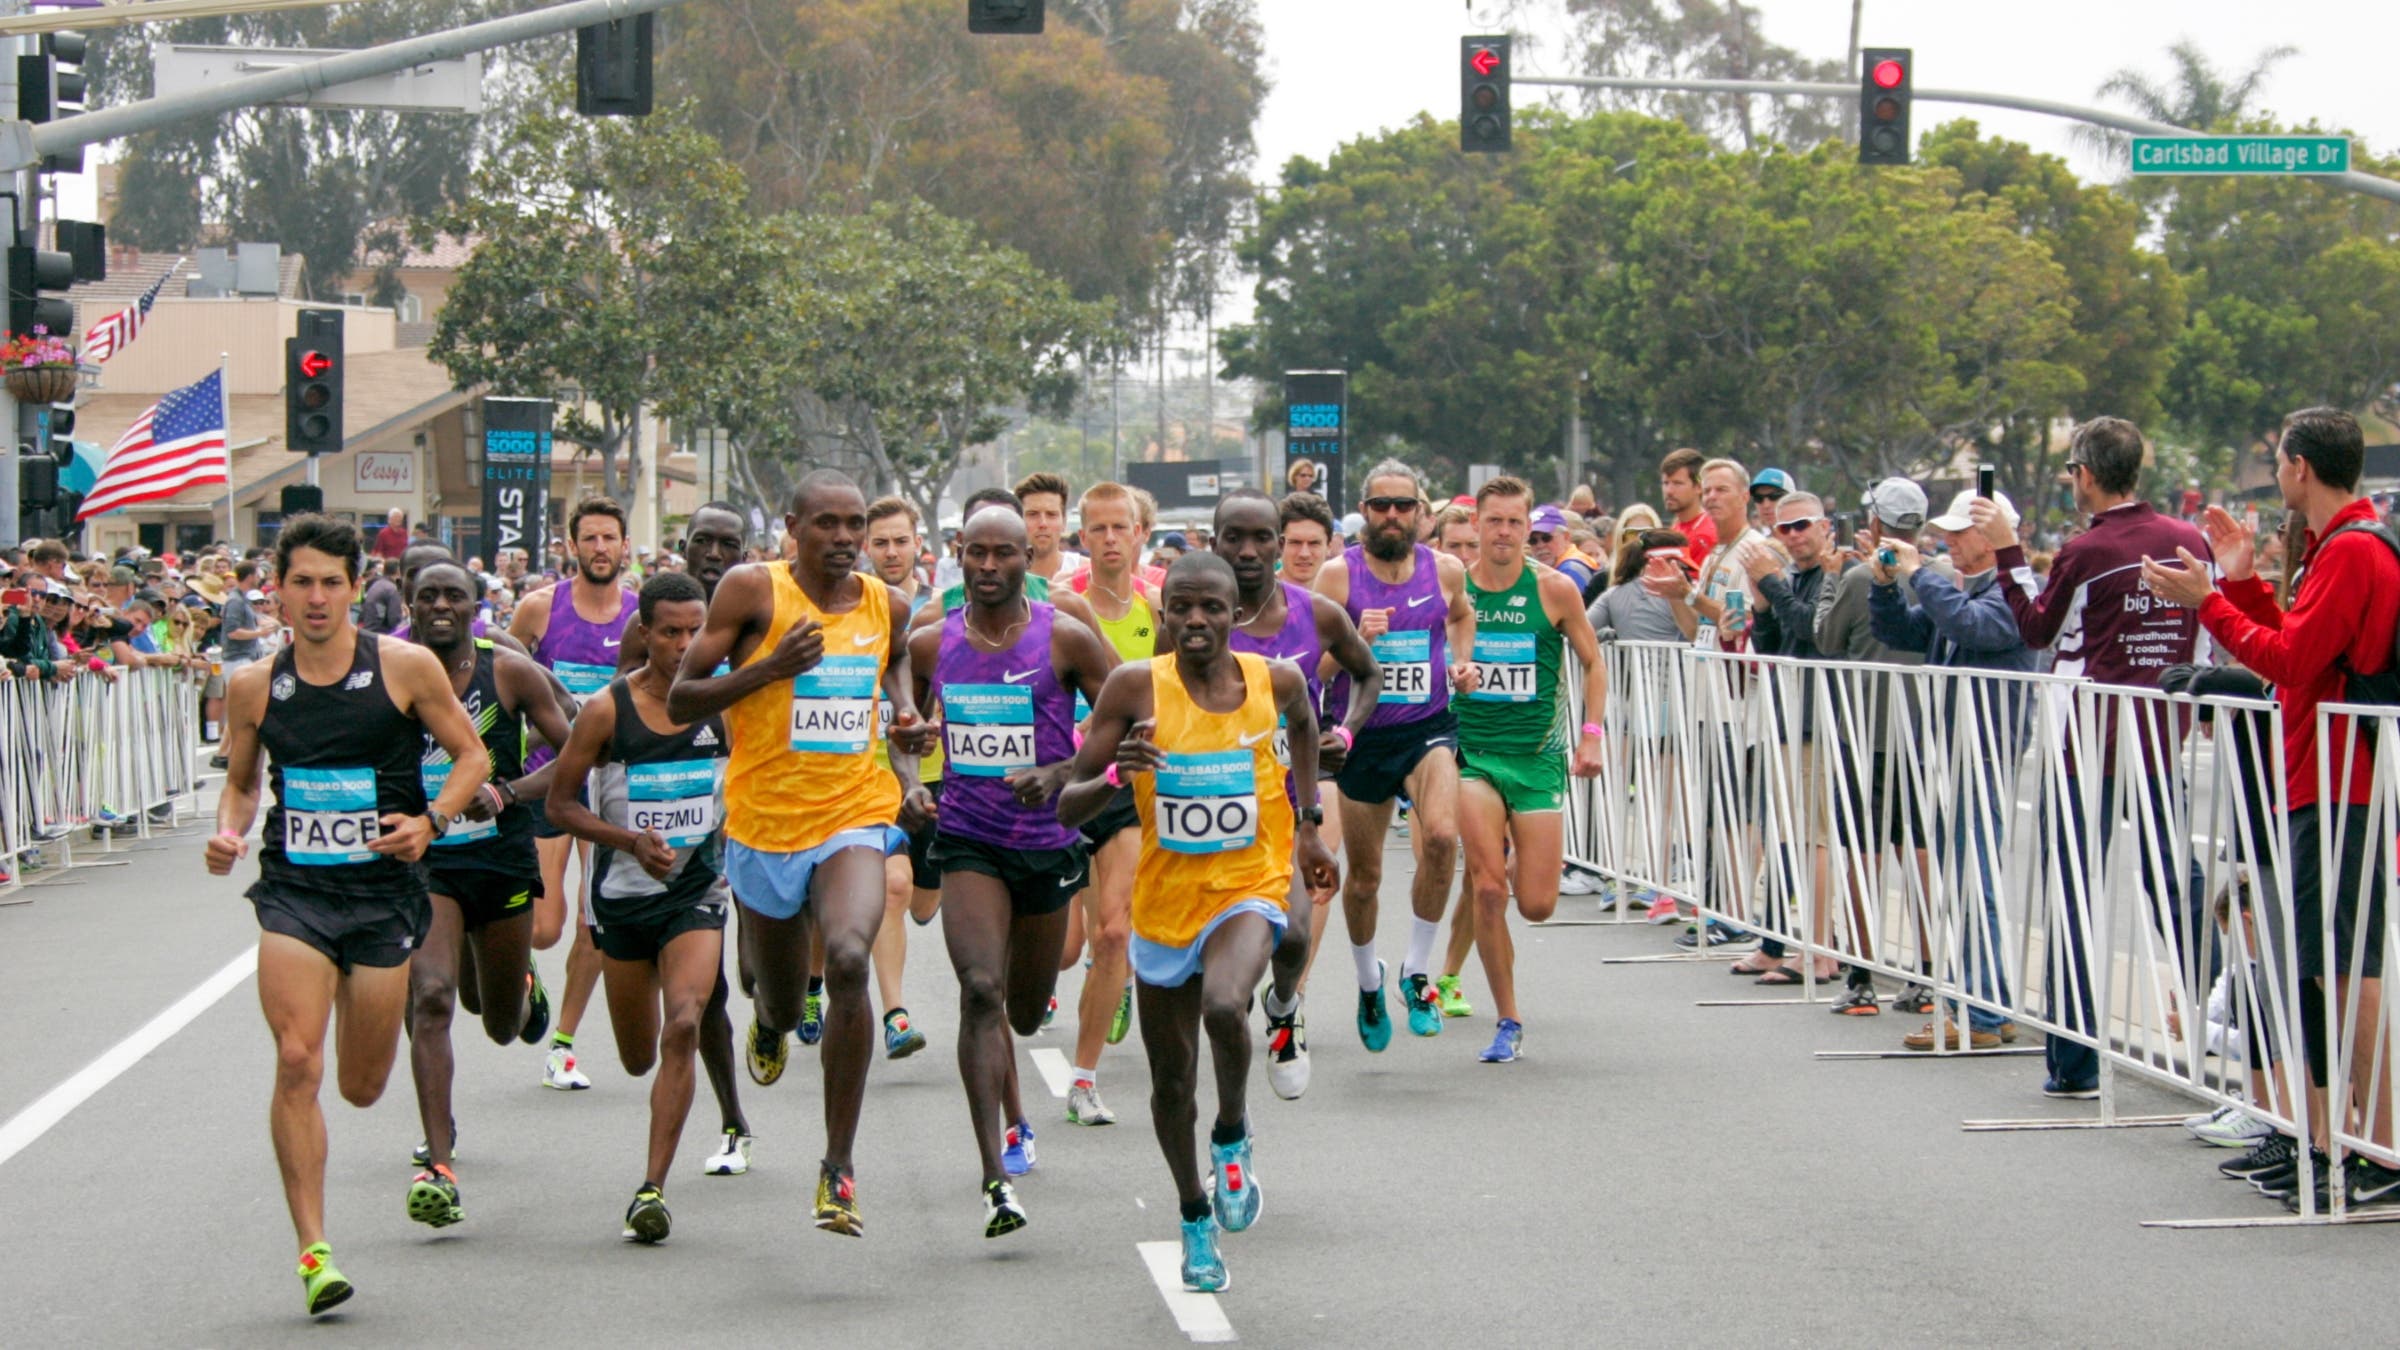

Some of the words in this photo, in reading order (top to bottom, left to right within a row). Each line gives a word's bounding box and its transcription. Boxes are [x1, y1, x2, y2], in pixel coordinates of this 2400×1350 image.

[2138, 143, 2229, 165] Carlsbad
[2237, 142, 2308, 170] Village
[2317, 144, 2340, 164] Dr
[1290, 413, 1339, 427] 5000
[487, 438, 536, 454] 5000
[1289, 442, 1339, 454] ELITE
[360, 456, 409, 486] Cessy's
[486, 467, 535, 480] ELITE
[2124, 593, 2150, 614] big
[1475, 610, 1526, 624] ELAND
[2118, 633, 2125, 643] 2
[2126, 645, 2133, 654] 2
[2129, 657, 2136, 666] 6
[1382, 667, 1424, 691] EER
[945, 695, 1001, 704] CARLSBAD
[951, 732, 1032, 758] LAGAT
[1222, 762, 1251, 773] 5000
[635, 807, 704, 831] GEZMU
[1162, 801, 1248, 837] TOO
[290, 816, 376, 847] PACE
